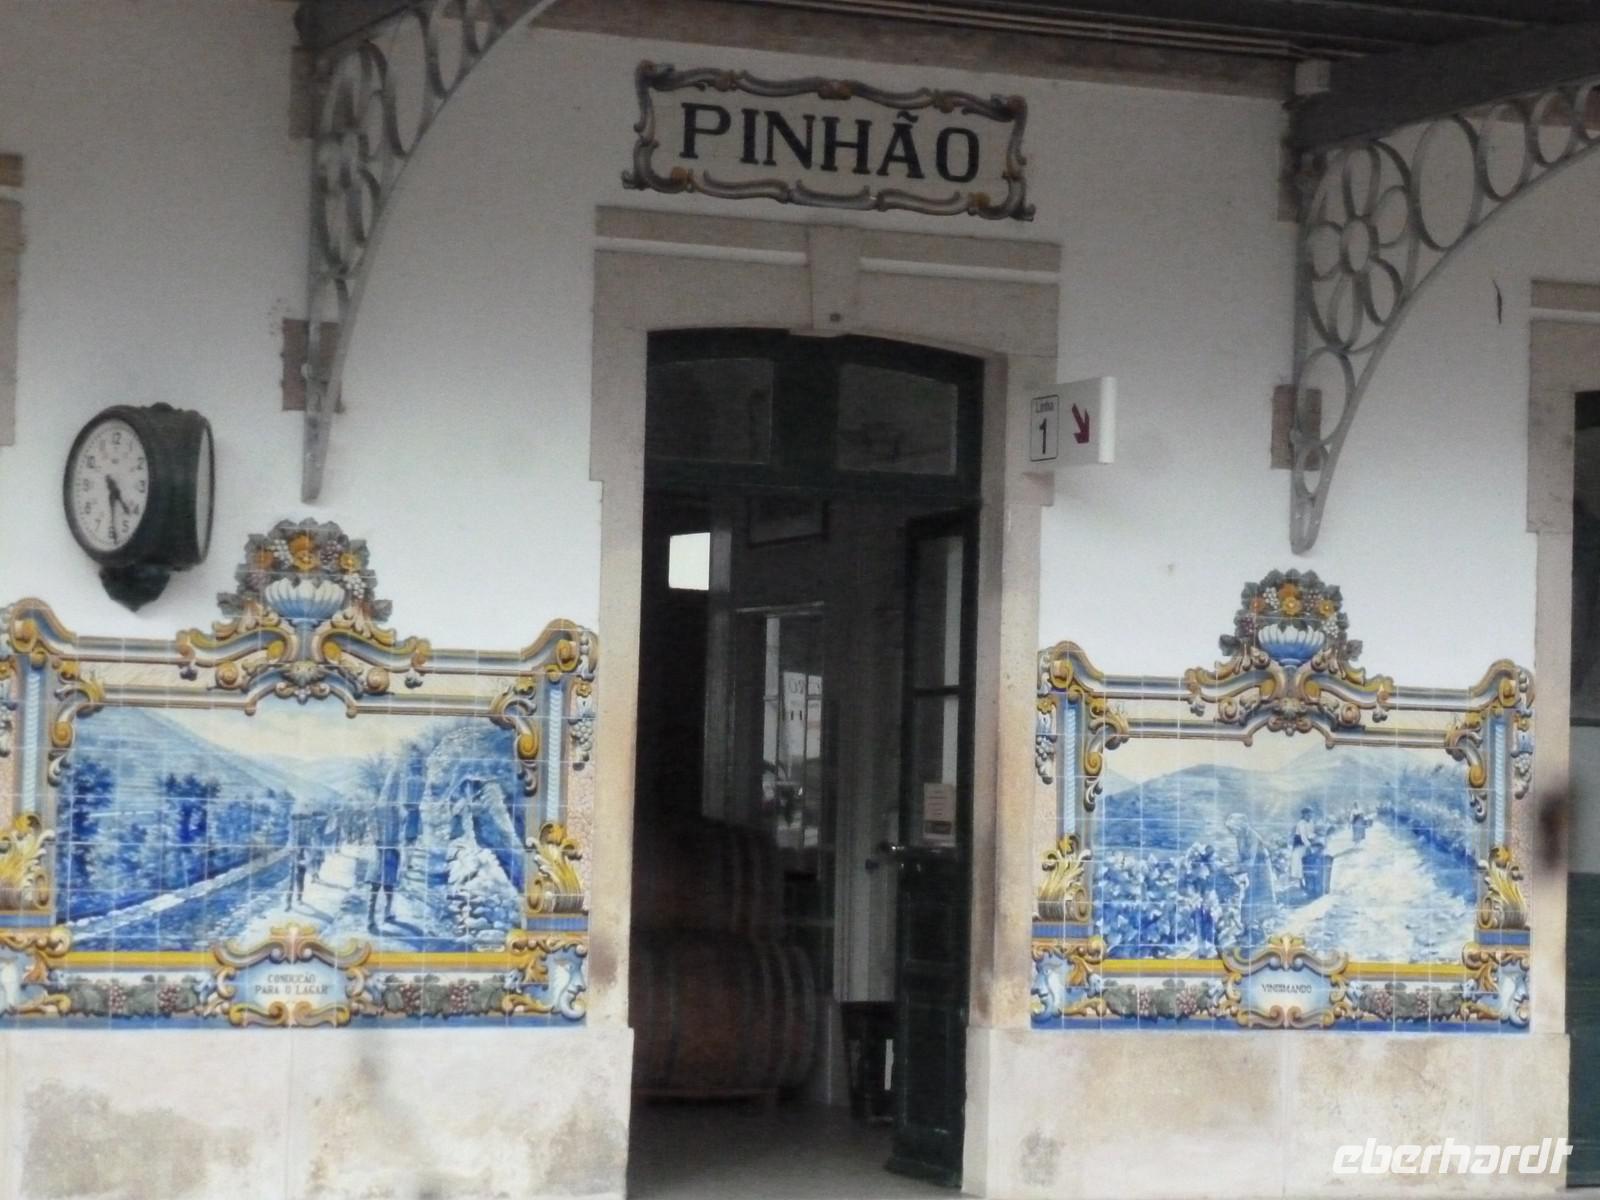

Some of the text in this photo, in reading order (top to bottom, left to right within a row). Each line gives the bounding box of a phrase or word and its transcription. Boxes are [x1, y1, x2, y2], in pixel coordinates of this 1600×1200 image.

[679, 102, 980, 183] PINHÃO
[112, 431, 122, 445] 12
[1039, 418, 1048, 455] 1
